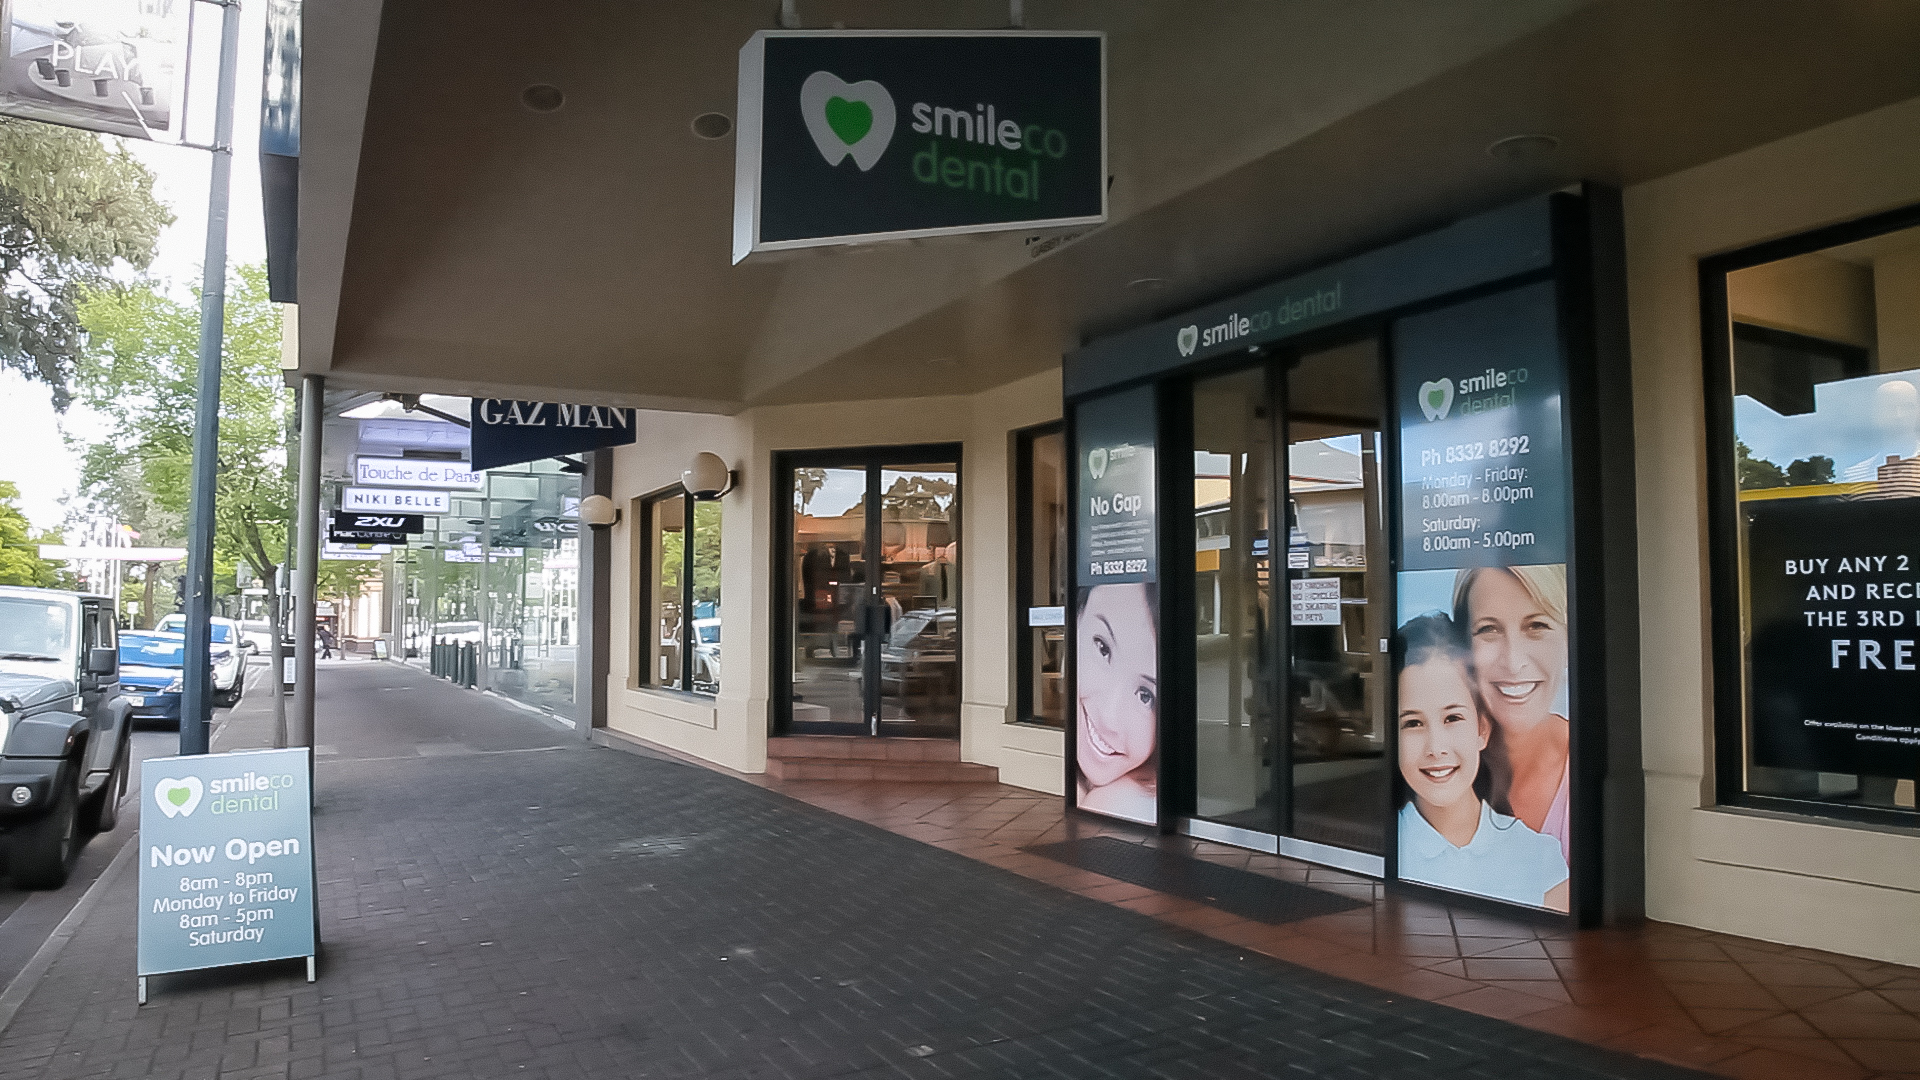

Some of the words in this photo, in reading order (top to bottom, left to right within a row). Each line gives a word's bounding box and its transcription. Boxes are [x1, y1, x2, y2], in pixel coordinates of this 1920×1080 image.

[52, 40, 138, 81] PLAY
[911, 101, 1068, 158] smileco
[912, 140, 1040, 201] dental
[1202, 311, 1273, 348] smileco
[1277, 280, 1342, 325] dental
[1459, 367, 1529, 395] smileco
[479, 398, 546, 426] GAZ
[556, 402, 627, 429] MAN
[1459, 387, 1516, 416] dental
[1421, 448, 1441, 467] Ph
[1445, 441, 1485, 464] 8332
[1488, 435, 1530, 459] 8292
[359, 463, 412, 480] Touche
[418, 467, 439, 482] de
[1422, 471, 1473, 490] Monday
[1484, 465, 1528, 484] Friday:
[354, 494, 388, 505] NIKI
[394, 495, 442, 507] BELLE
[1090, 496, 1110, 517] No
[1112, 493, 1142, 517] Gap
[1422, 492, 1470, 509] 8.00am
[1481, 485, 1534, 504] 8.00pm
[1422, 514, 1481, 533] Saturday:
[1422, 535, 1471, 552] 8.00am
[1482, 530, 1535, 550] 5.00pm
[1785, 558, 1829, 575] BUY
[1837, 555, 1888, 573] ANY
[1896, 554, 1910, 571] 2
[1805, 584, 1856, 601] AND
[1804, 611, 1848, 627] THE
[1856, 610, 1905, 627] 3RD
[210, 771, 294, 794] smileco
[210, 790, 279, 815] dental
[151, 844, 216, 868] Now
[224, 838, 300, 864] Open
[179, 876, 219, 892] 8am
[235, 872, 273, 889] 8pm
[152, 894, 224, 914] Monday
[228, 891, 245, 905] to
[249, 885, 298, 903] Friday
[179, 913, 219, 930] 8am
[235, 908, 274, 926] 5pm
[189, 926, 265, 947] Saturday
